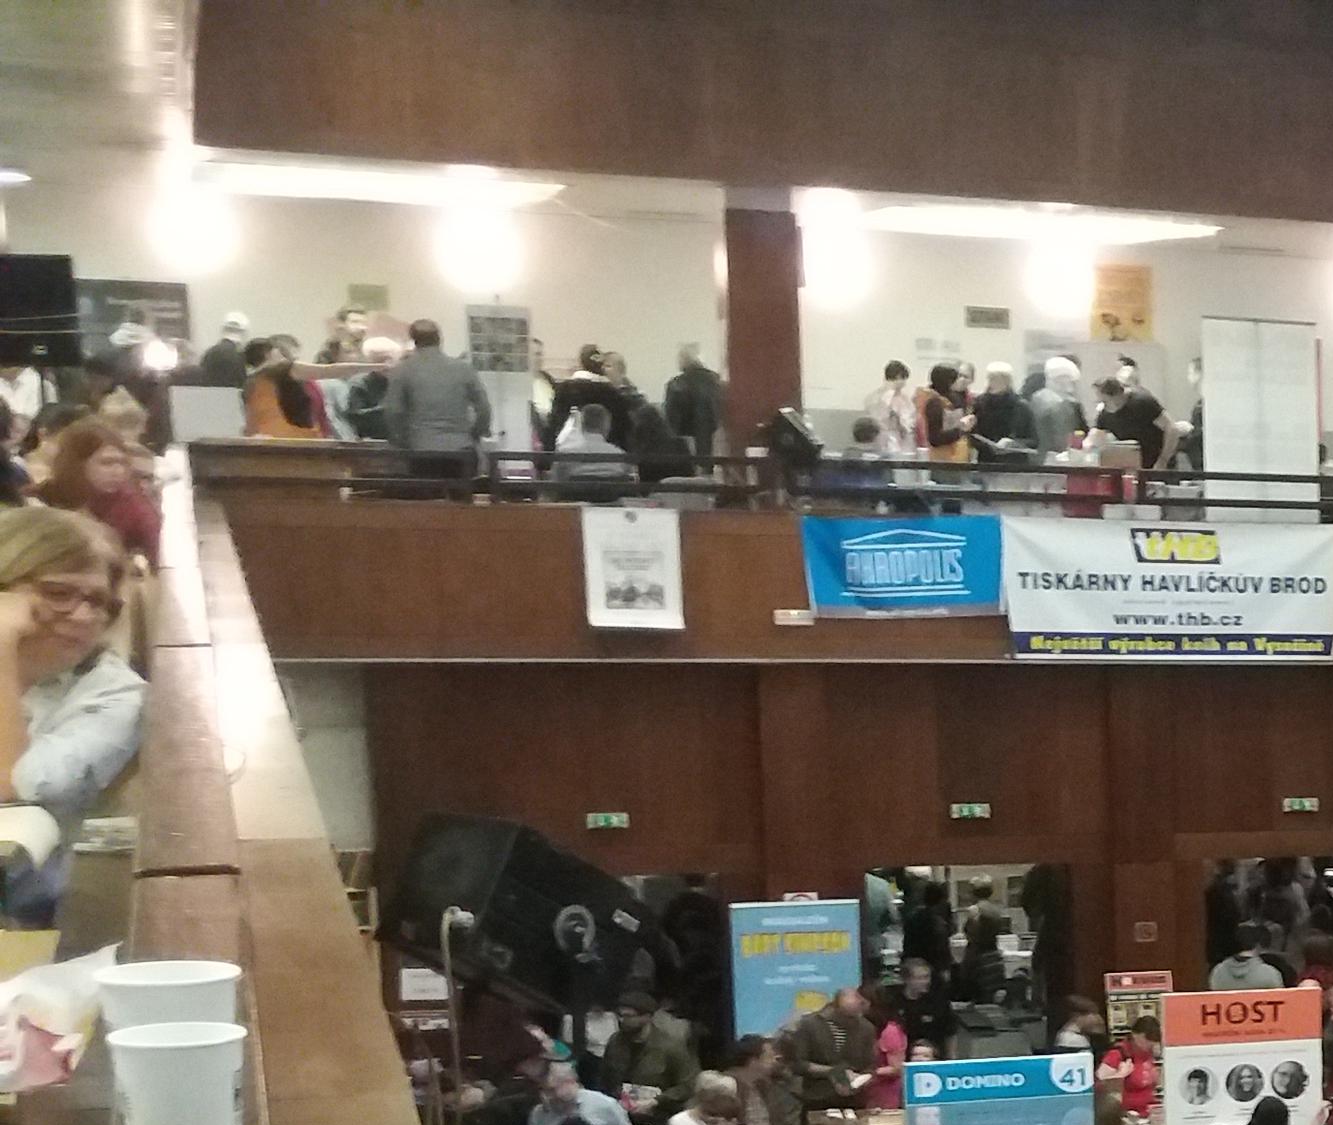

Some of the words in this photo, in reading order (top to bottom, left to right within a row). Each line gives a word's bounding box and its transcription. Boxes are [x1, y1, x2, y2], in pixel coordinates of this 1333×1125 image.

[1017, 570, 1132, 592] TISKÁRNY
[1269, 576, 1328, 595] BROD
[1112, 611, 1244, 626] www.thb.cz
[1201, 1000, 1285, 1026] HOST
[945, 1072, 1026, 1091] DOMINO
[1059, 1067, 1087, 1088] 41
